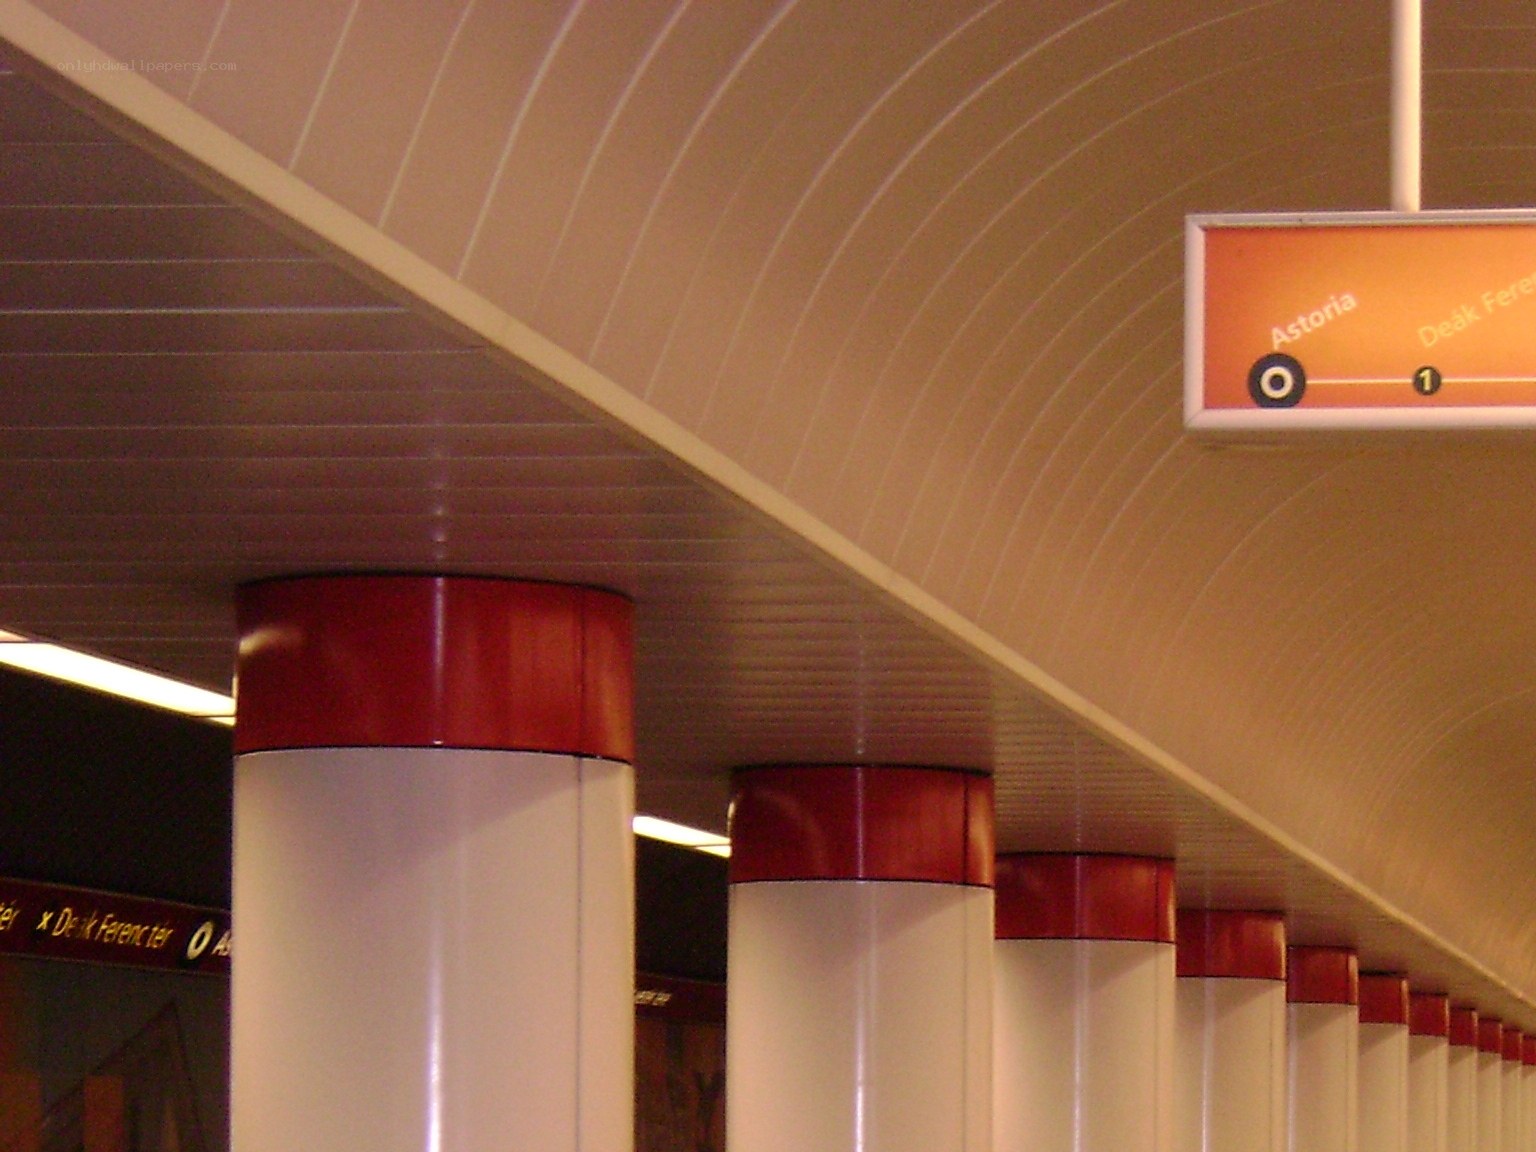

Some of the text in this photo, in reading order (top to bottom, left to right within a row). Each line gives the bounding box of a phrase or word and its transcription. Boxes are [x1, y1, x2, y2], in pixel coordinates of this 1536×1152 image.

[1270, 293, 1357, 350] Astoria
[1417, 303, 1482, 348] Deák
[1418, 368, 1433, 391] 1
[95, 913, 150, 946] Ferenc
